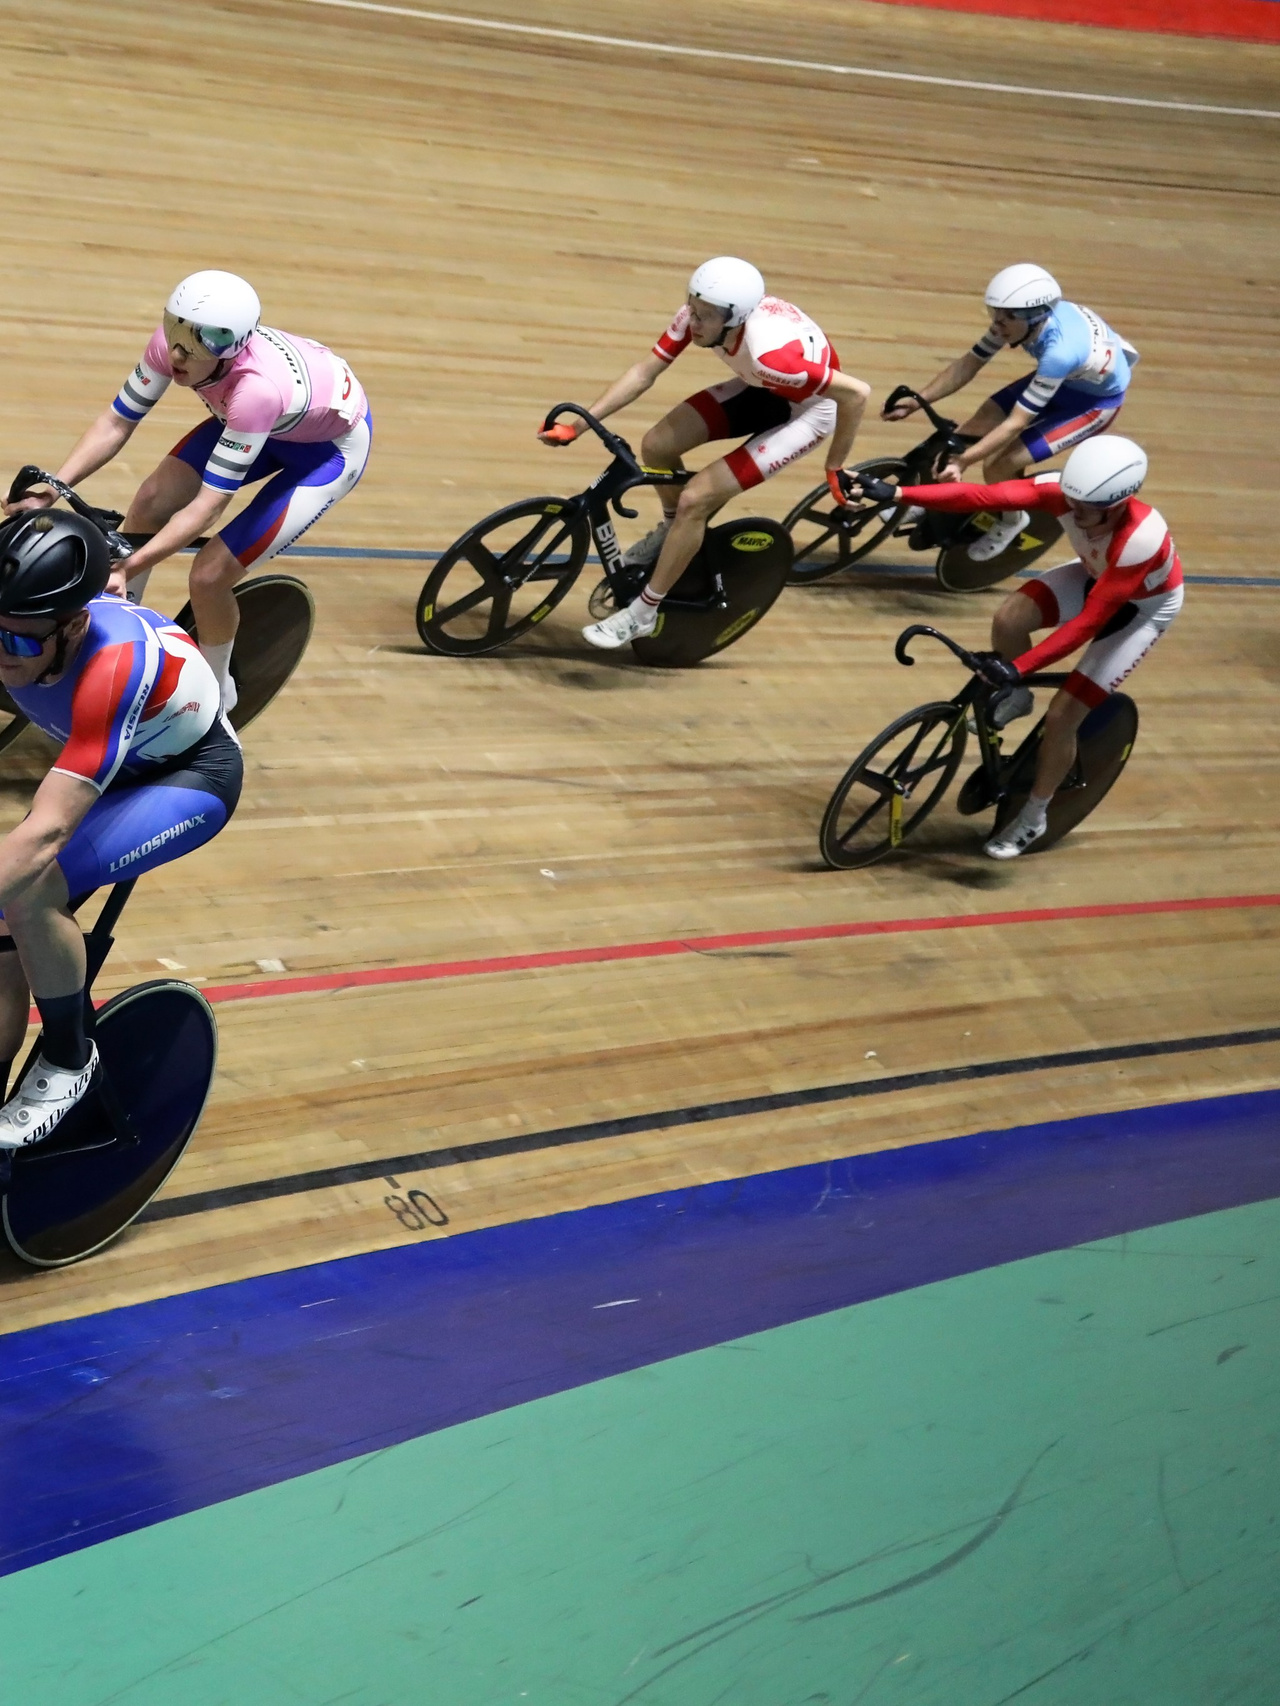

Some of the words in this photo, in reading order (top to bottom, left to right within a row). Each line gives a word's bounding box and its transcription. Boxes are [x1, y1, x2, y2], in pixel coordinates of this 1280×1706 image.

[1098, 349, 1112, 375] 2
[596, 520, 626, 575] BMC
[124, 683, 150, 741] RUSSIA
[109, 813, 206, 874] LOKOSPHINX
[384, 1189, 450, 1231] 80
